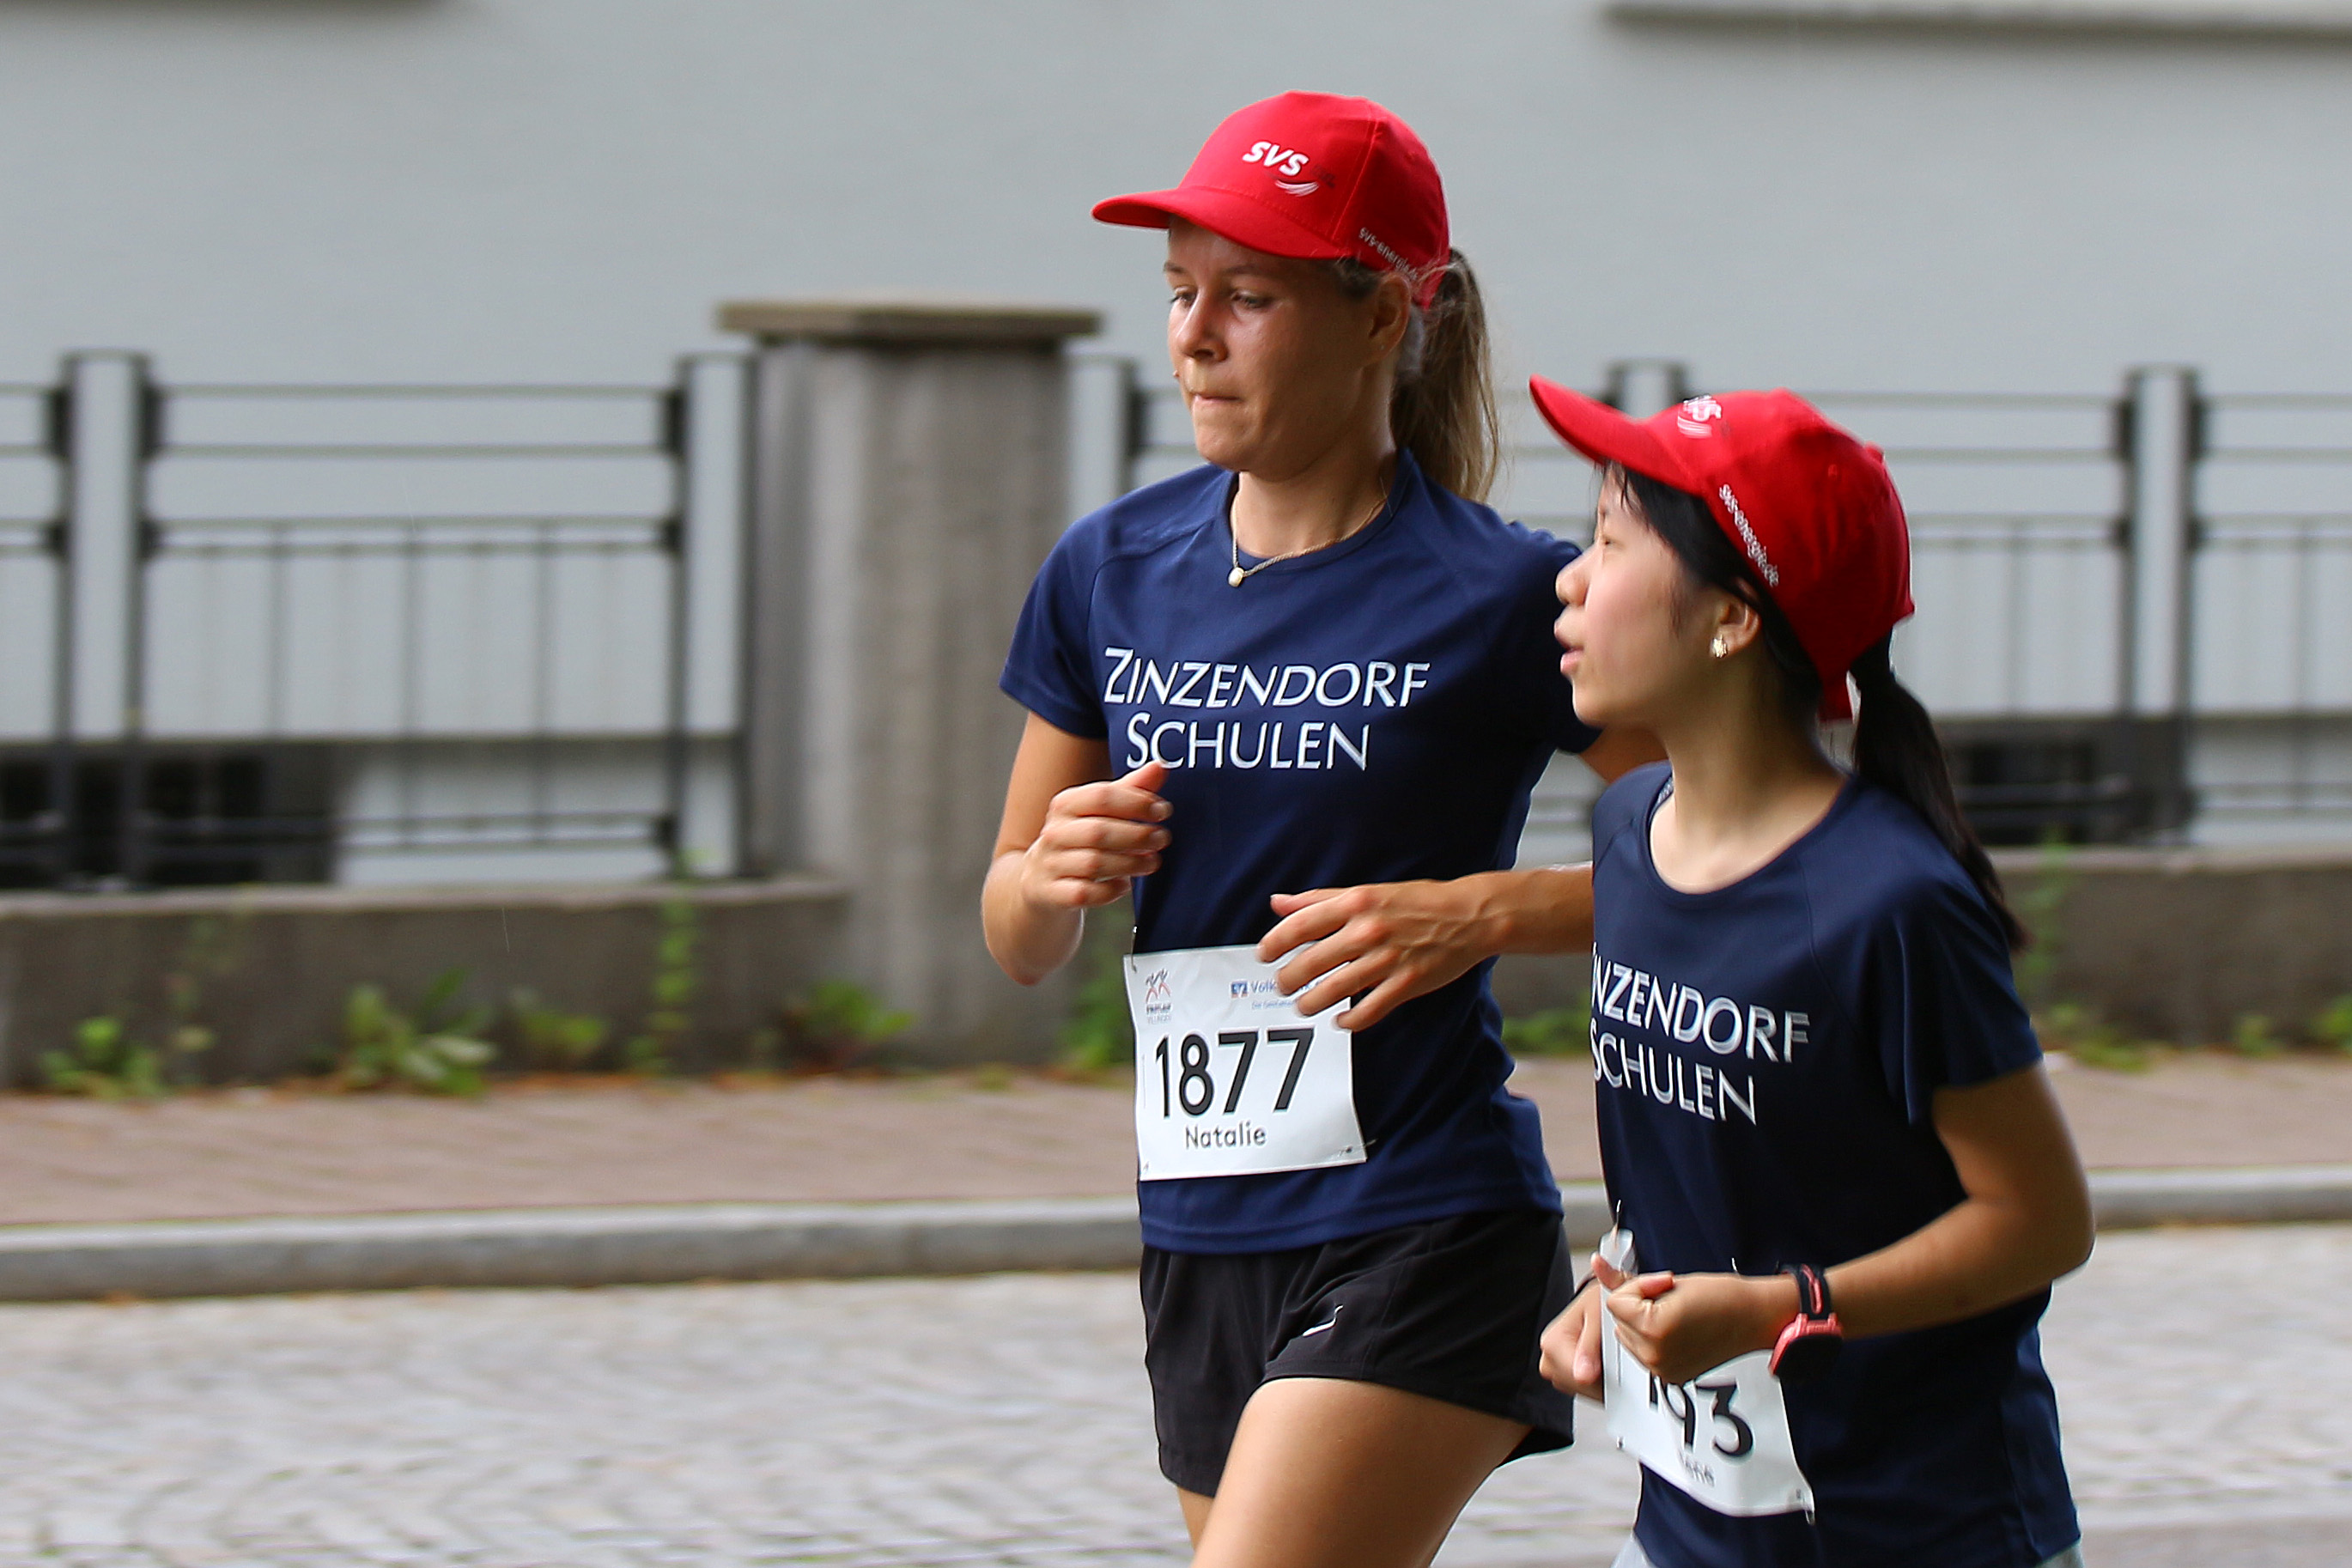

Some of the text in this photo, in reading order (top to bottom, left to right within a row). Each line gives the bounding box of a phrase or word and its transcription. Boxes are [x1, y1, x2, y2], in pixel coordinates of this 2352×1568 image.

[1242, 141, 1310, 176] SVS
[1104, 647, 1431, 708] ZINZENDORF
[1126, 711, 1370, 771] SCHULEN
[1155, 1027, 1316, 1120] 1877
[1589, 1018, 1758, 1127] SCHULEN
[1185, 1120, 1268, 1149] Natalie
